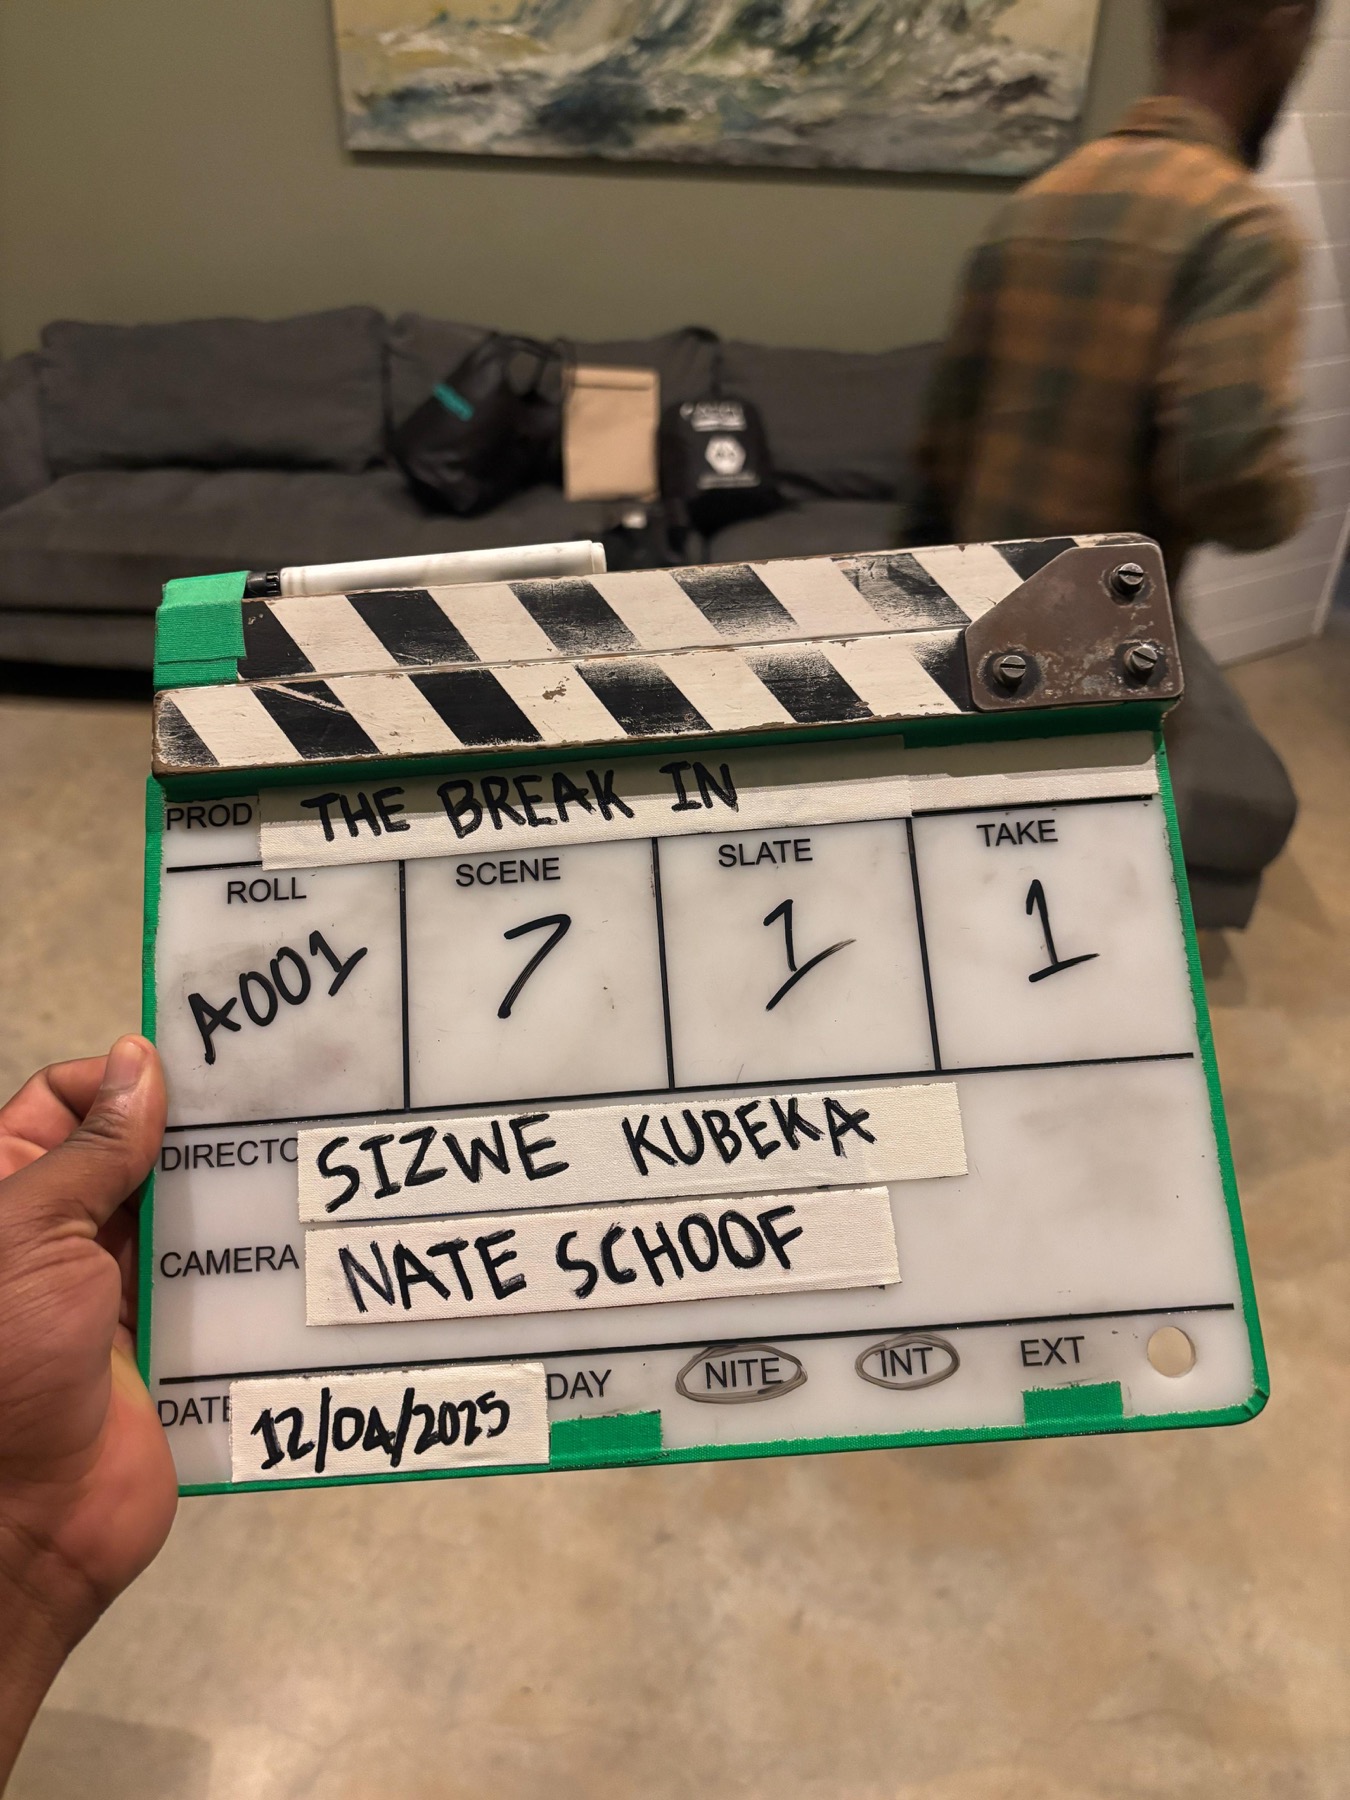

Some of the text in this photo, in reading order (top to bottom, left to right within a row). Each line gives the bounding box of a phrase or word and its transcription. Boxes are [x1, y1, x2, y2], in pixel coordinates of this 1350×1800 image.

[166, 802, 253, 831] PROD
[300, 760, 739, 842] THE BREAK IN
[976, 819, 1059, 848] TAKE
[455, 857, 561, 887] SCENE
[717, 838, 813, 868] SLATE
[226, 876, 308, 905] ROLL
[497, 913, 572, 1019] 7
[763, 899, 857, 1012] 1
[1026, 879, 1100, 983] 1
[187, 930, 367, 1065] A001
[316, 1098, 877, 1213] SIZWE KUBEKA
[160, 1244, 300, 1279] CAMERA
[338, 1204, 804, 1313] NATE SCHOOF
[546, 1336, 1086, 1400] DAY NITE INT EXT
